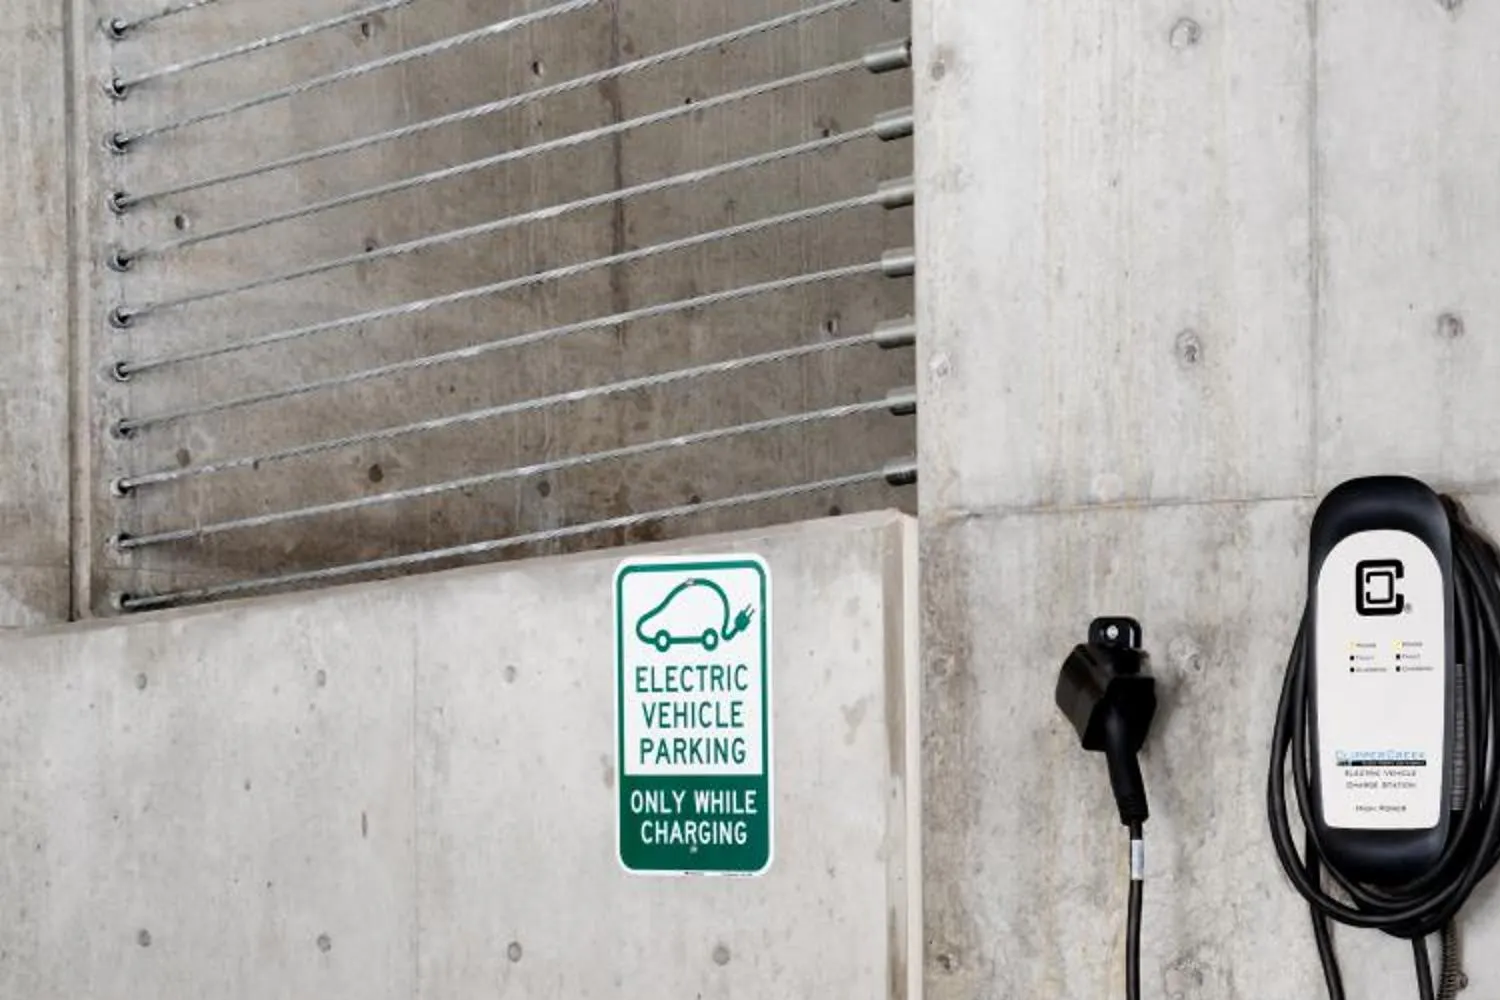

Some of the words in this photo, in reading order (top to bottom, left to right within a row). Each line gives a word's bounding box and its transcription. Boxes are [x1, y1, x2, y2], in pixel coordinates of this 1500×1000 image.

[635, 664, 749, 693] ELECTRIC
[642, 701, 744, 729] VEHICLE
[640, 737, 746, 765] PARKING
[631, 790, 686, 814] ONLY
[694, 790, 758, 814] WHILE
[640, 820, 748, 845] CHARGING
